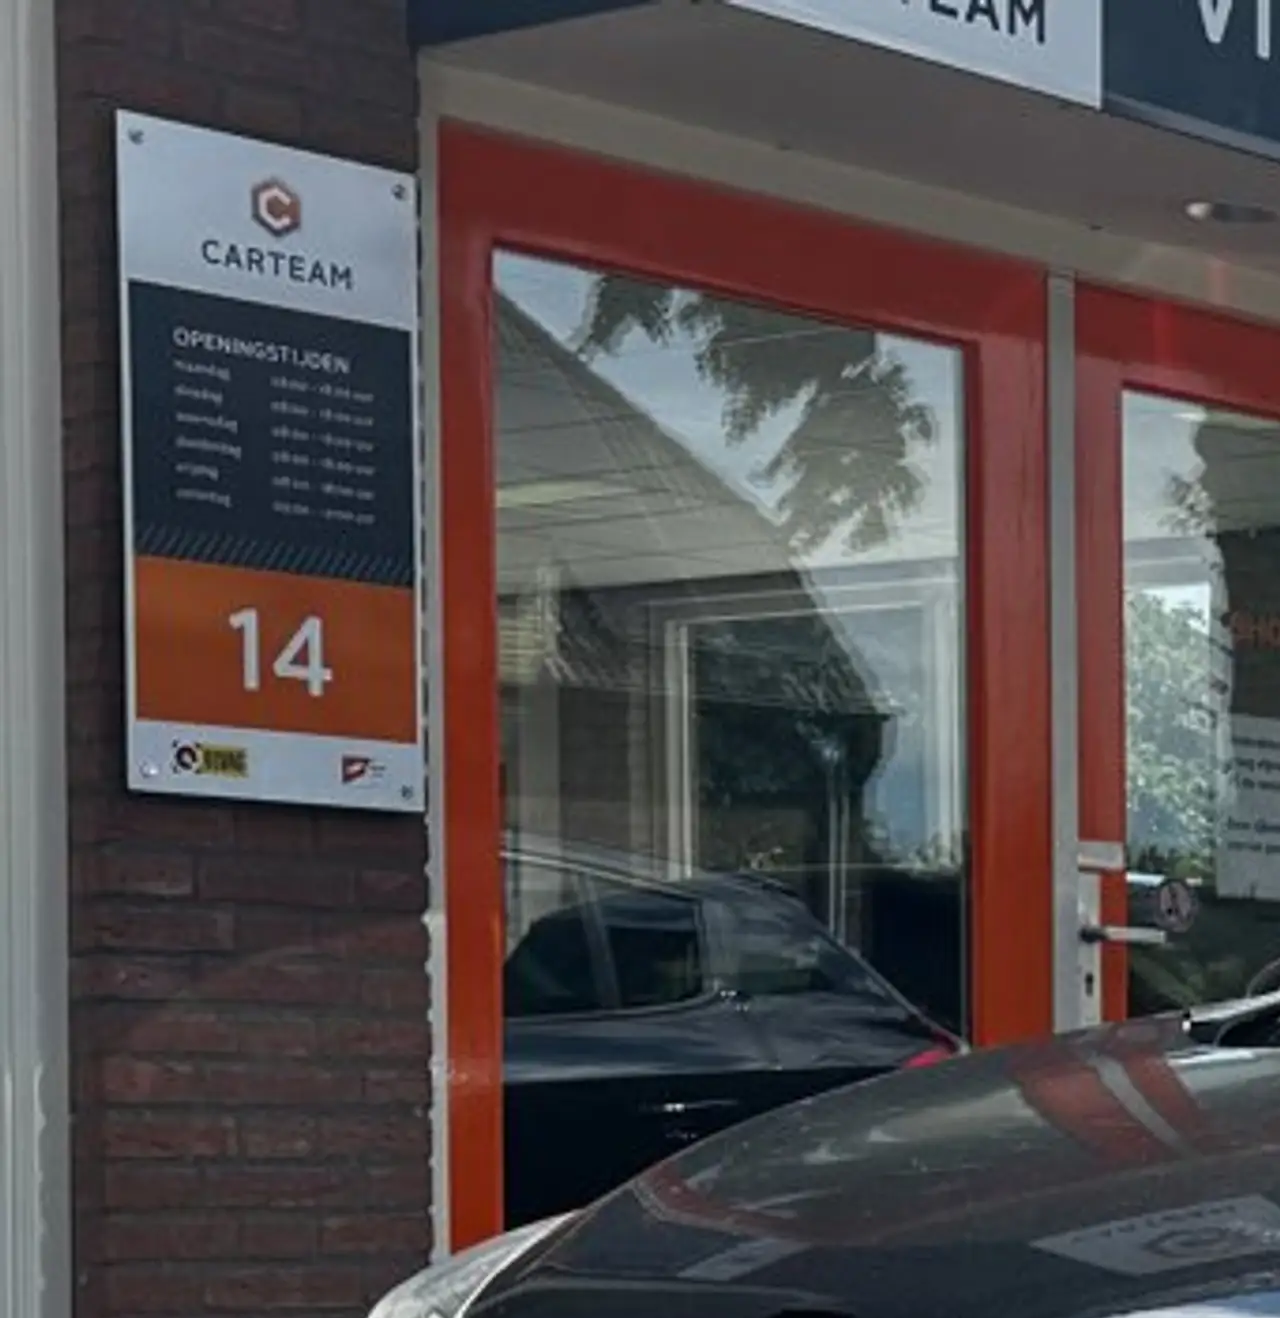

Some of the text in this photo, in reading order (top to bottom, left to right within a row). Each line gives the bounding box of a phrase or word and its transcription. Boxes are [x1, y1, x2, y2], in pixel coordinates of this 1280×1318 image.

[202, 240, 353, 290] CARTEAM
[173, 327, 351, 374] OPENINGSTIJDEN
[229, 607, 333, 697] 14
